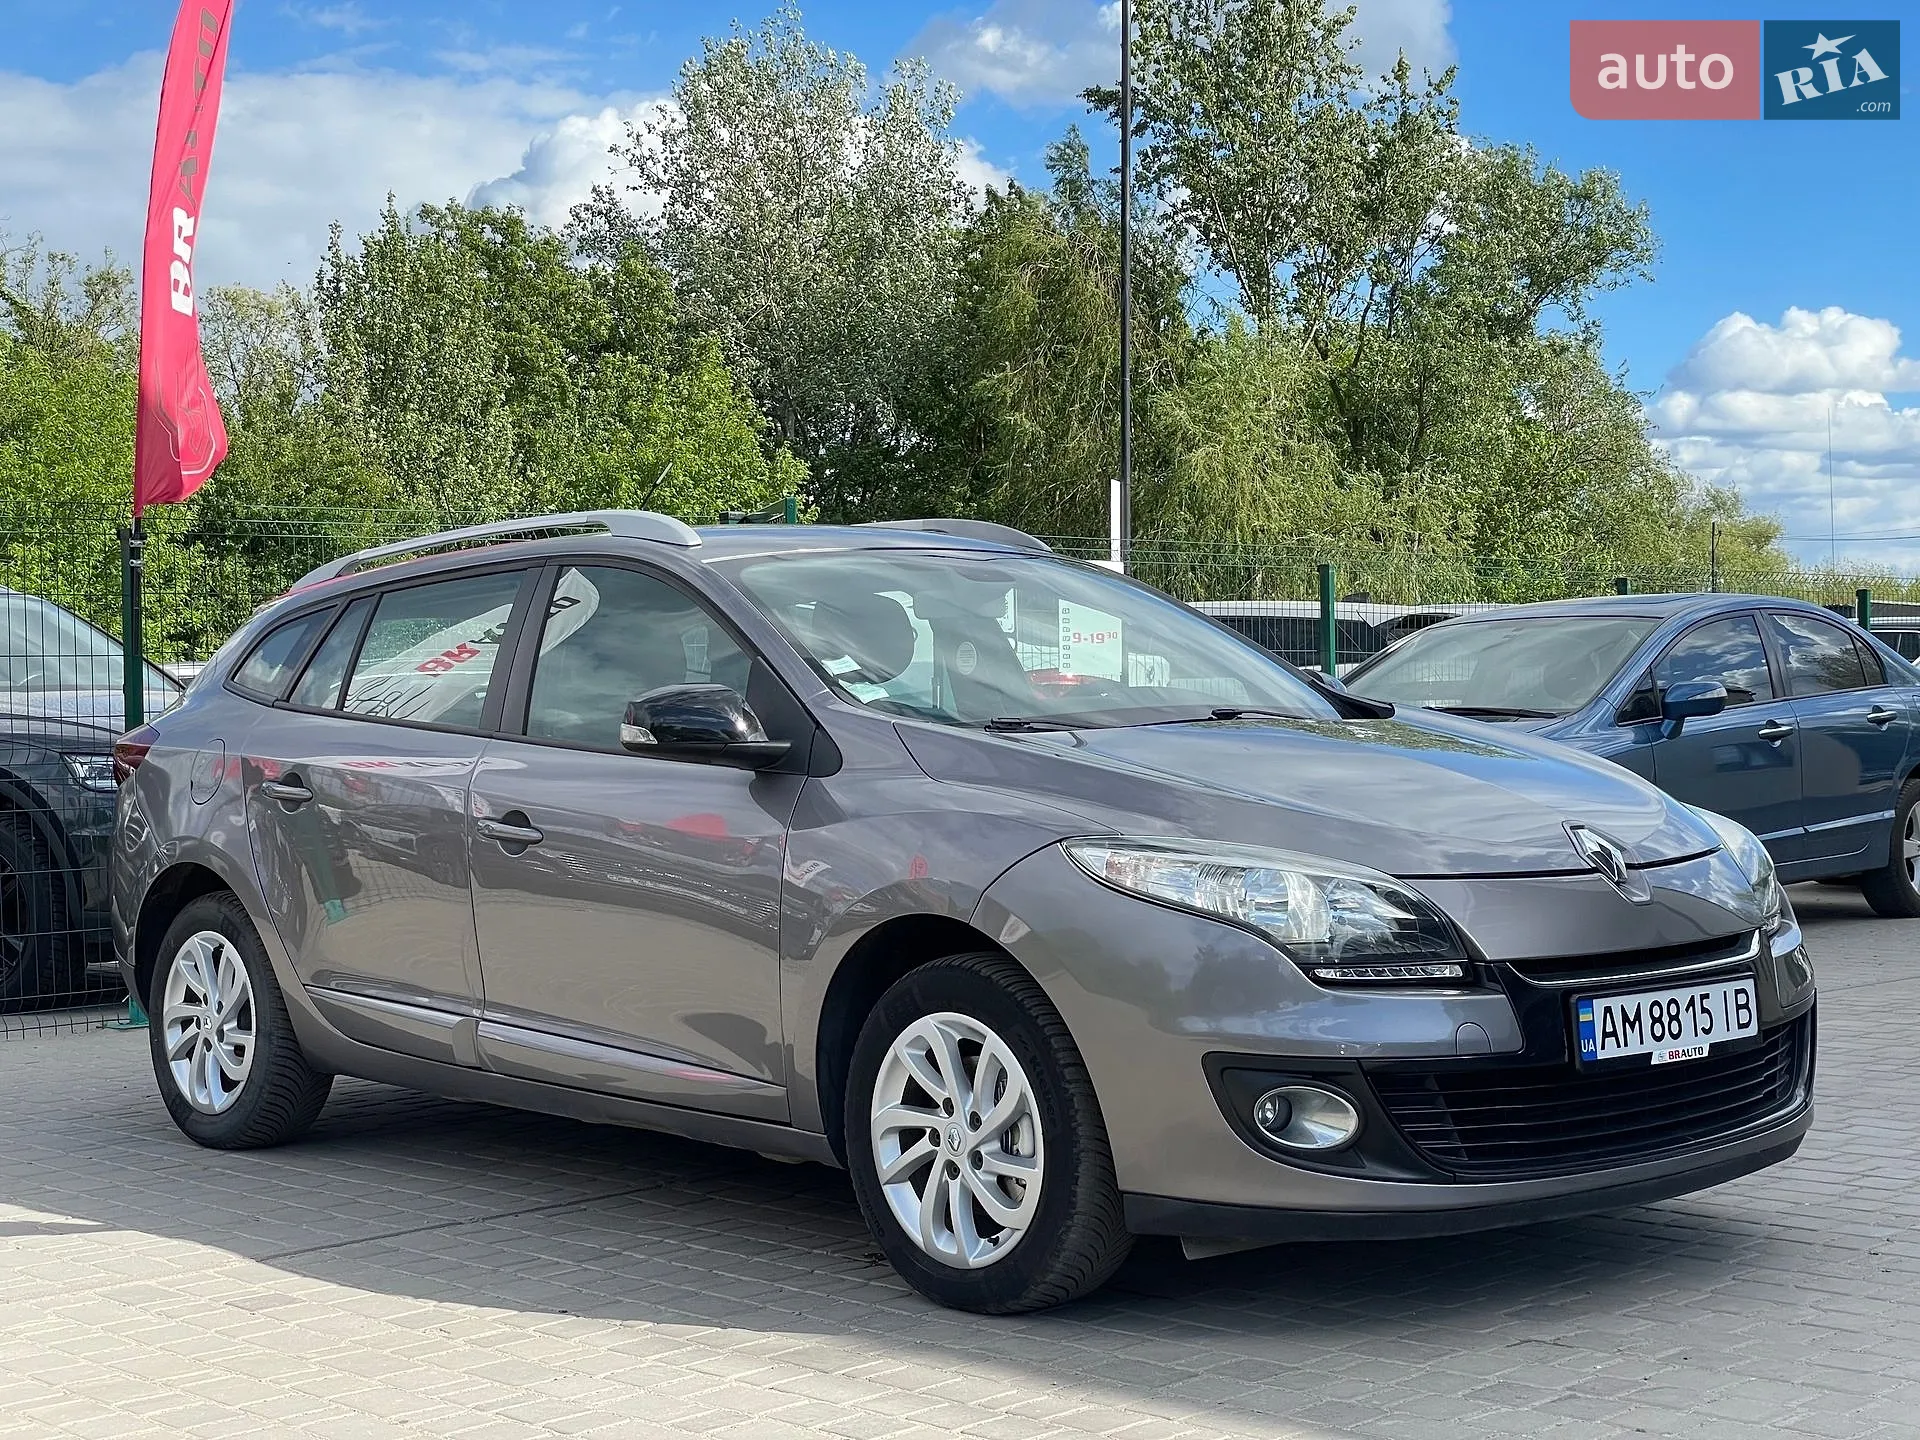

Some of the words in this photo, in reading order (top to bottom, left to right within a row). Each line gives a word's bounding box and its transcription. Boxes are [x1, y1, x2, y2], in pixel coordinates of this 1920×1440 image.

[1648, 992, 1715, 1043] 8815
[1581, 1038, 1596, 1053] UA
[1667, 1046, 1705, 1060] BRAUTO
